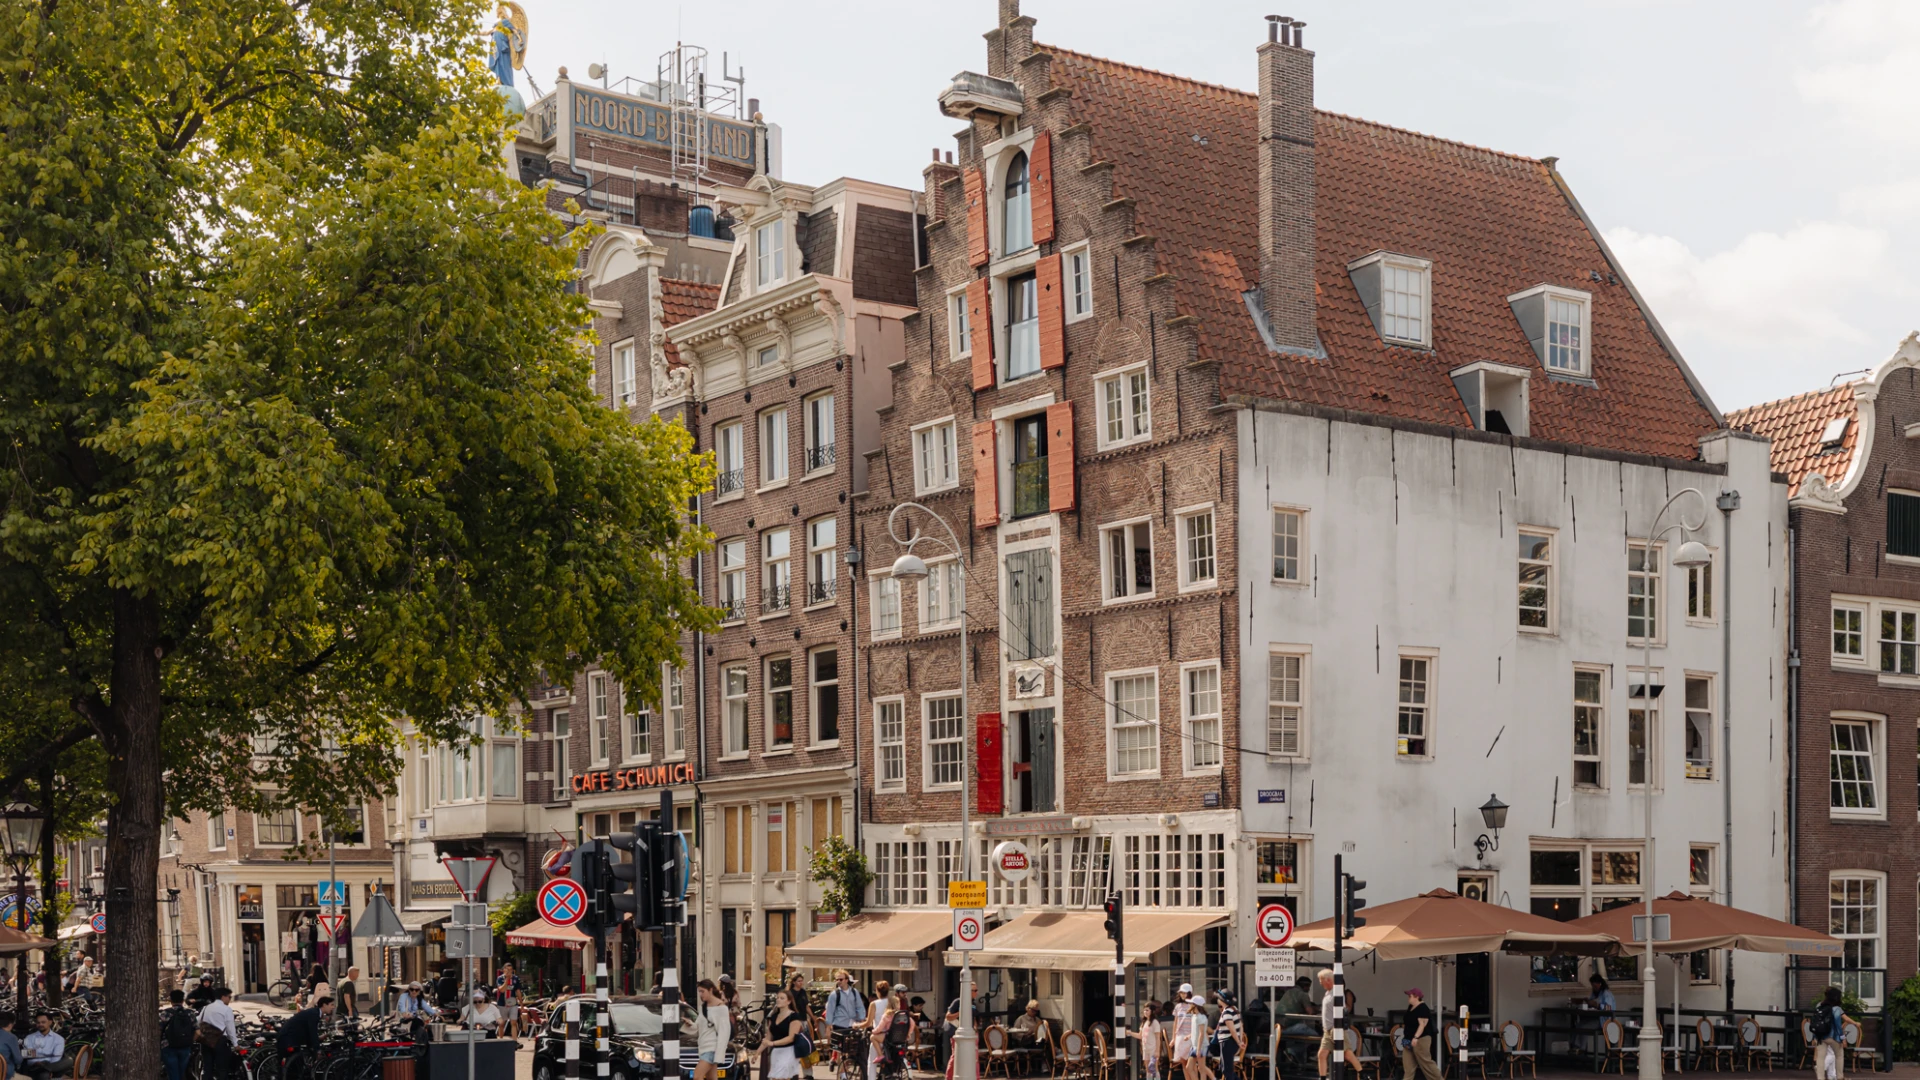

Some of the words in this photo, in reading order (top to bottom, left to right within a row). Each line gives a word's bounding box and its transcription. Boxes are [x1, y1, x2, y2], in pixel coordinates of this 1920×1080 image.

[572, 772, 609, 793] CAFE
[426, 884, 434, 894] EN
[962, 924, 976, 934] 30
